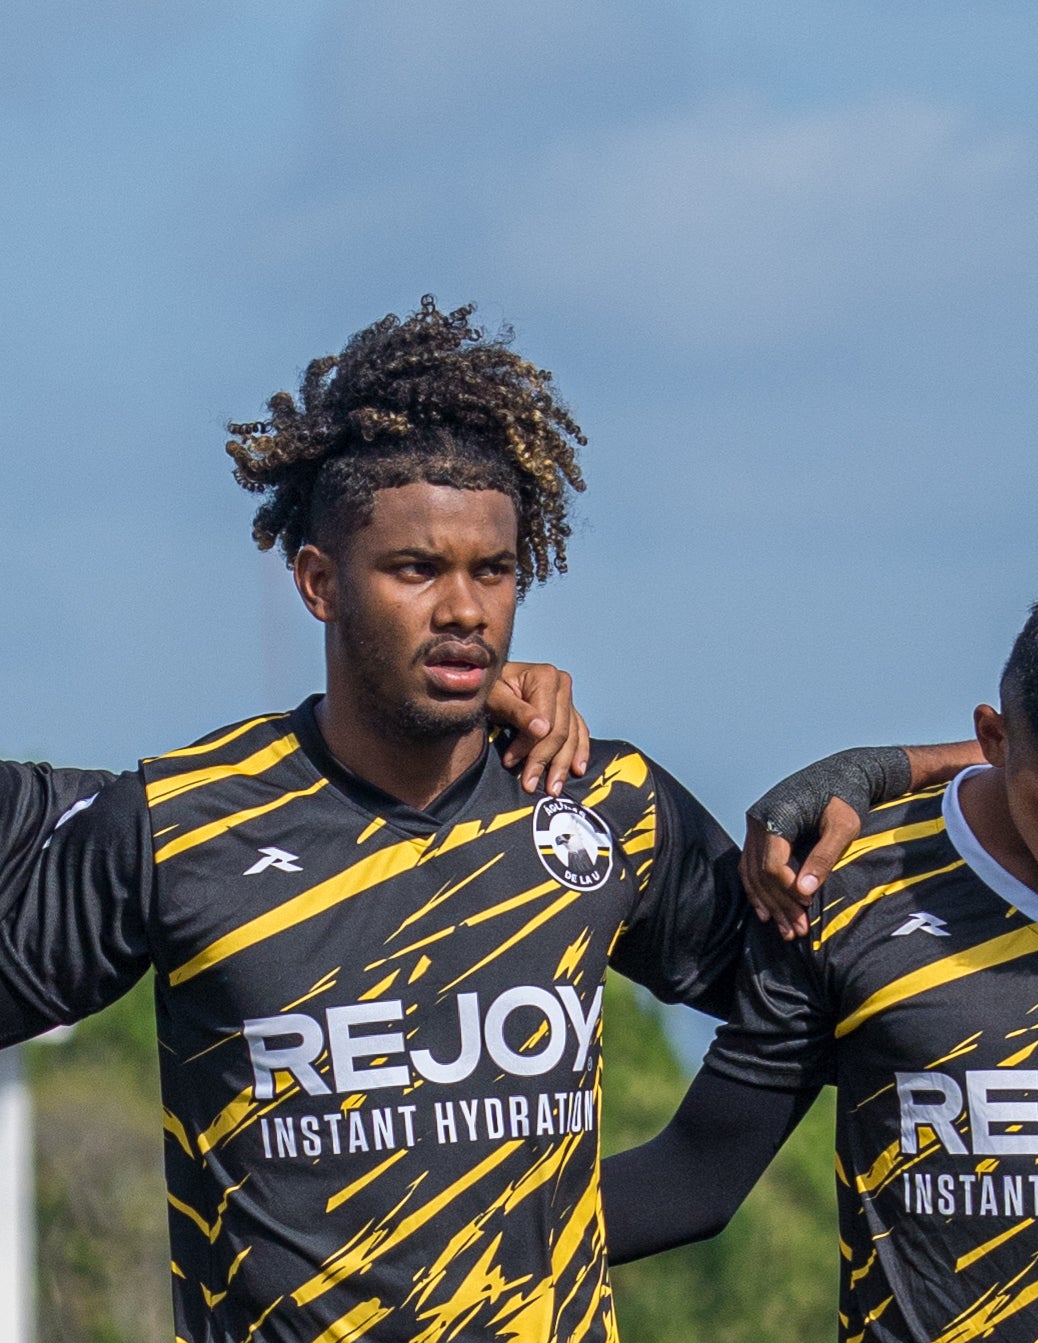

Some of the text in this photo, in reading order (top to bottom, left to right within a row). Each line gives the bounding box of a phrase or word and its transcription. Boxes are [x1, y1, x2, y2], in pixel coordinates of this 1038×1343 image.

[565, 870, 600, 884] DE LA U
[243, 985, 604, 1100] REJOY
[261, 1089, 594, 1159] INSTANT HYDRATION
